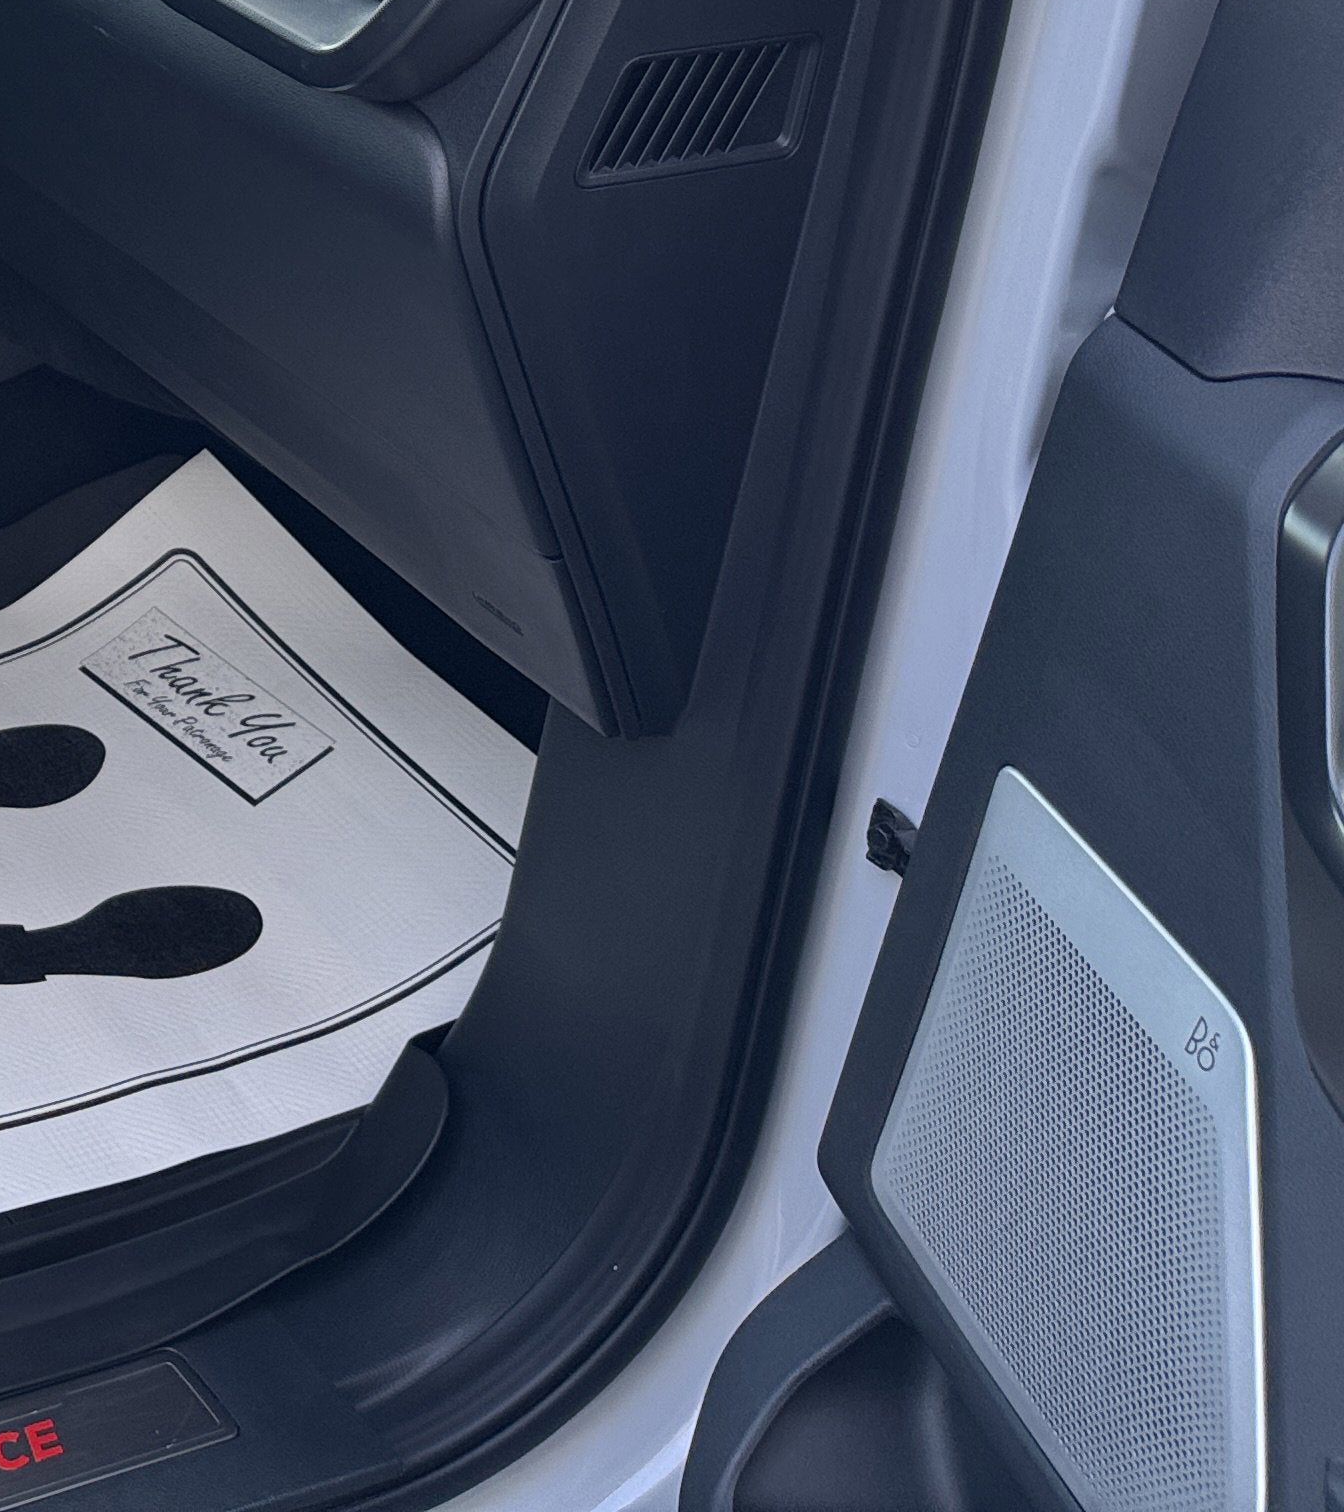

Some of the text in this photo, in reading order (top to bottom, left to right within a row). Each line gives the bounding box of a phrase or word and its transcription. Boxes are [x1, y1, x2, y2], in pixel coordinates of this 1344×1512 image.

[124, 678, 233, 763] For Your Patronage
[127, 634, 297, 764] Thank You
